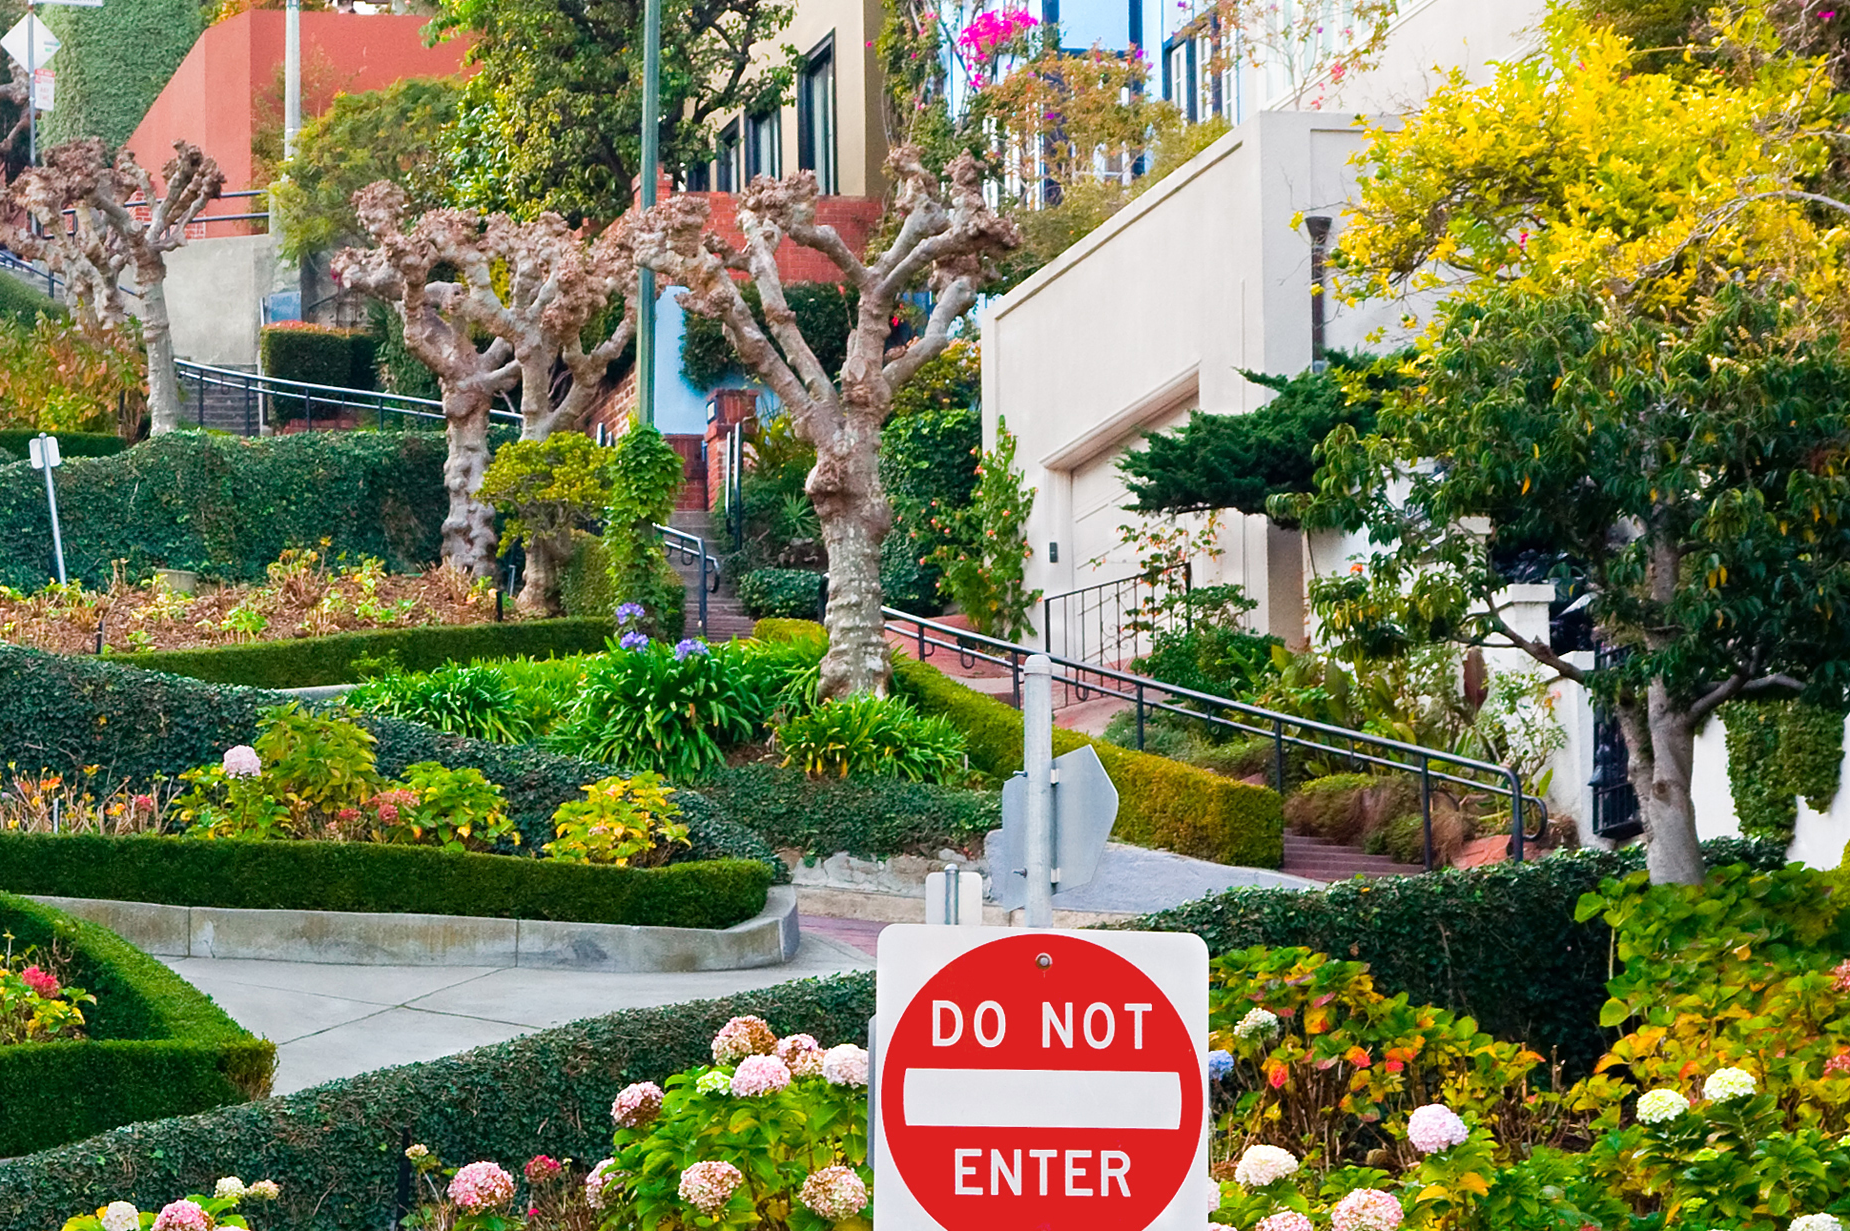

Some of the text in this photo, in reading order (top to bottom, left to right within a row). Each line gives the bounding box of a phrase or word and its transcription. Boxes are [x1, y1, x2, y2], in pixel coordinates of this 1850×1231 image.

[932, 999, 1154, 1050] DO NOT
[954, 1148, 1132, 1198] ENTER
